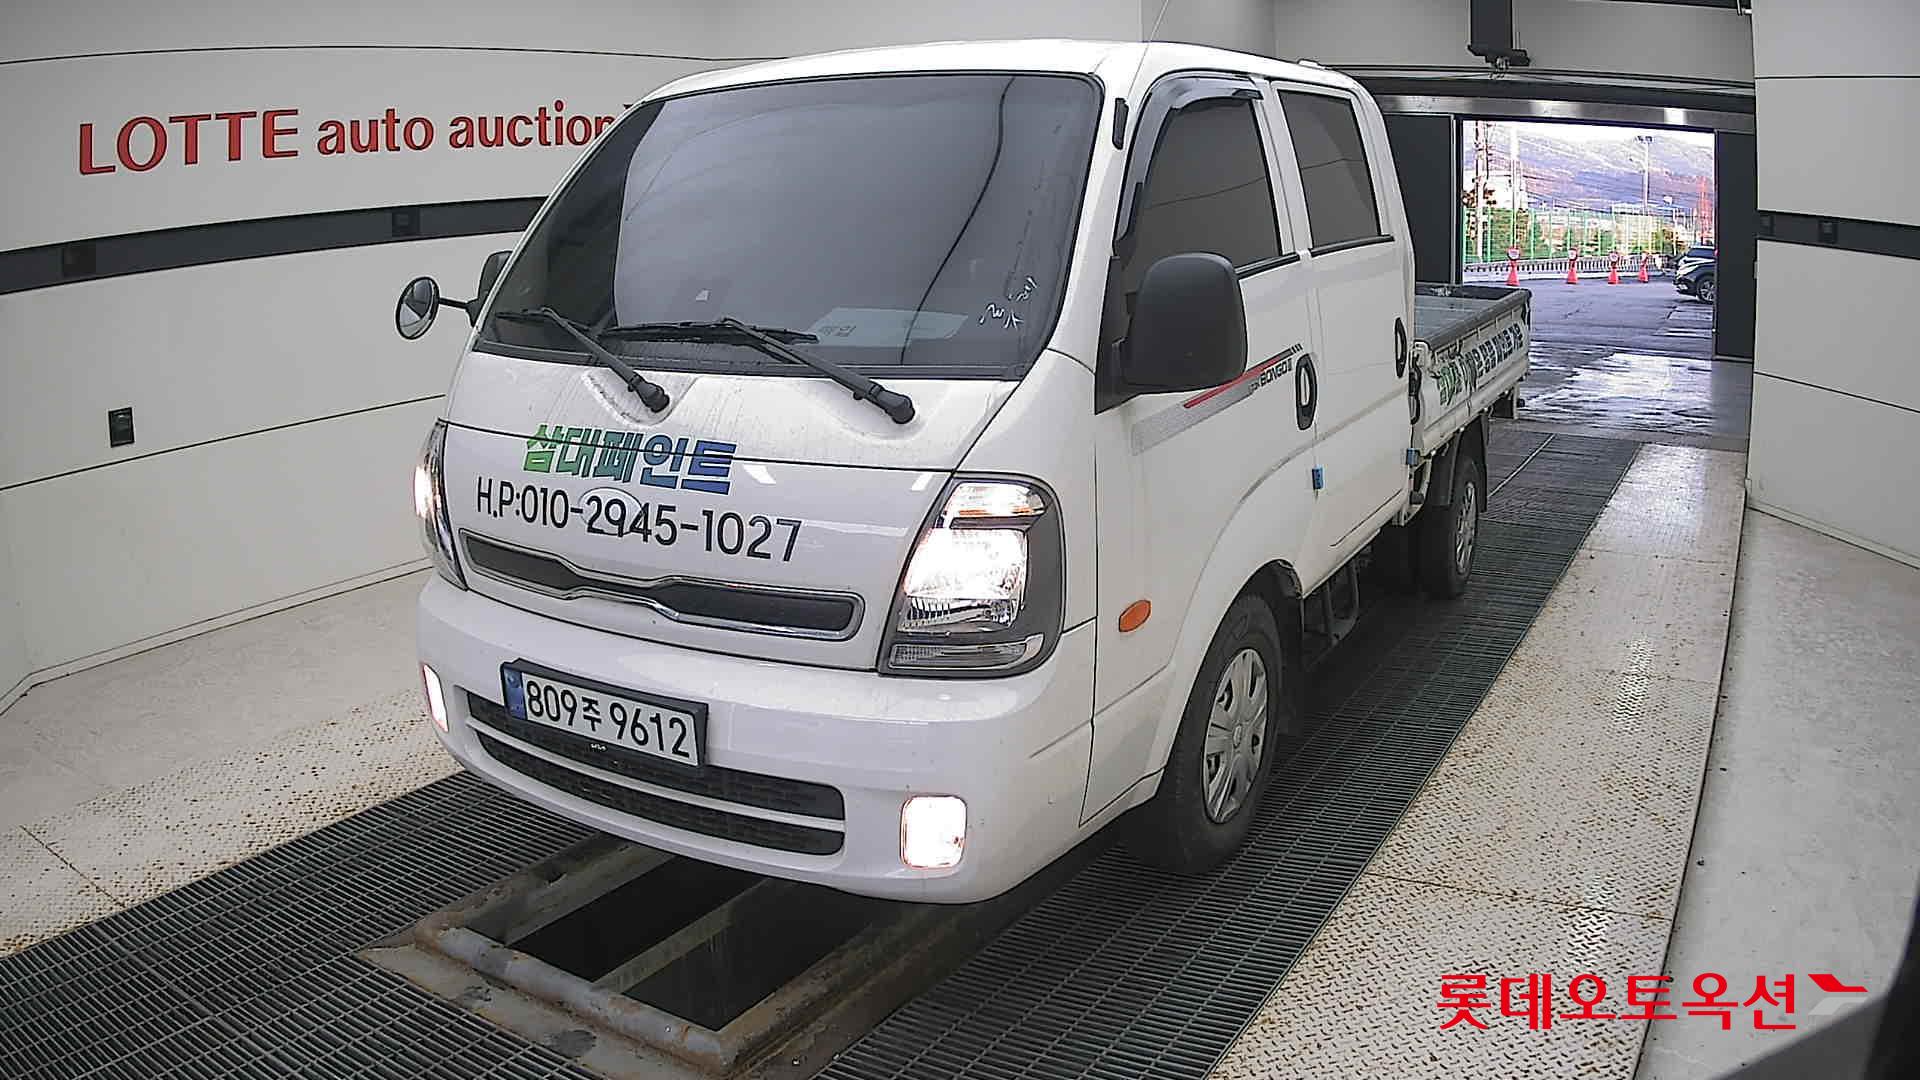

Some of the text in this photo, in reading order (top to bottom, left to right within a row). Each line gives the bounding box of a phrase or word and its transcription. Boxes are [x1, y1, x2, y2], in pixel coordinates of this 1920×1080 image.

[79, 109, 299, 175] LOTTE
[317, 107, 434, 155] auto
[523, 424, 737, 495] 삼대페인트
[526, 680, 691, 759] 809주 9612
